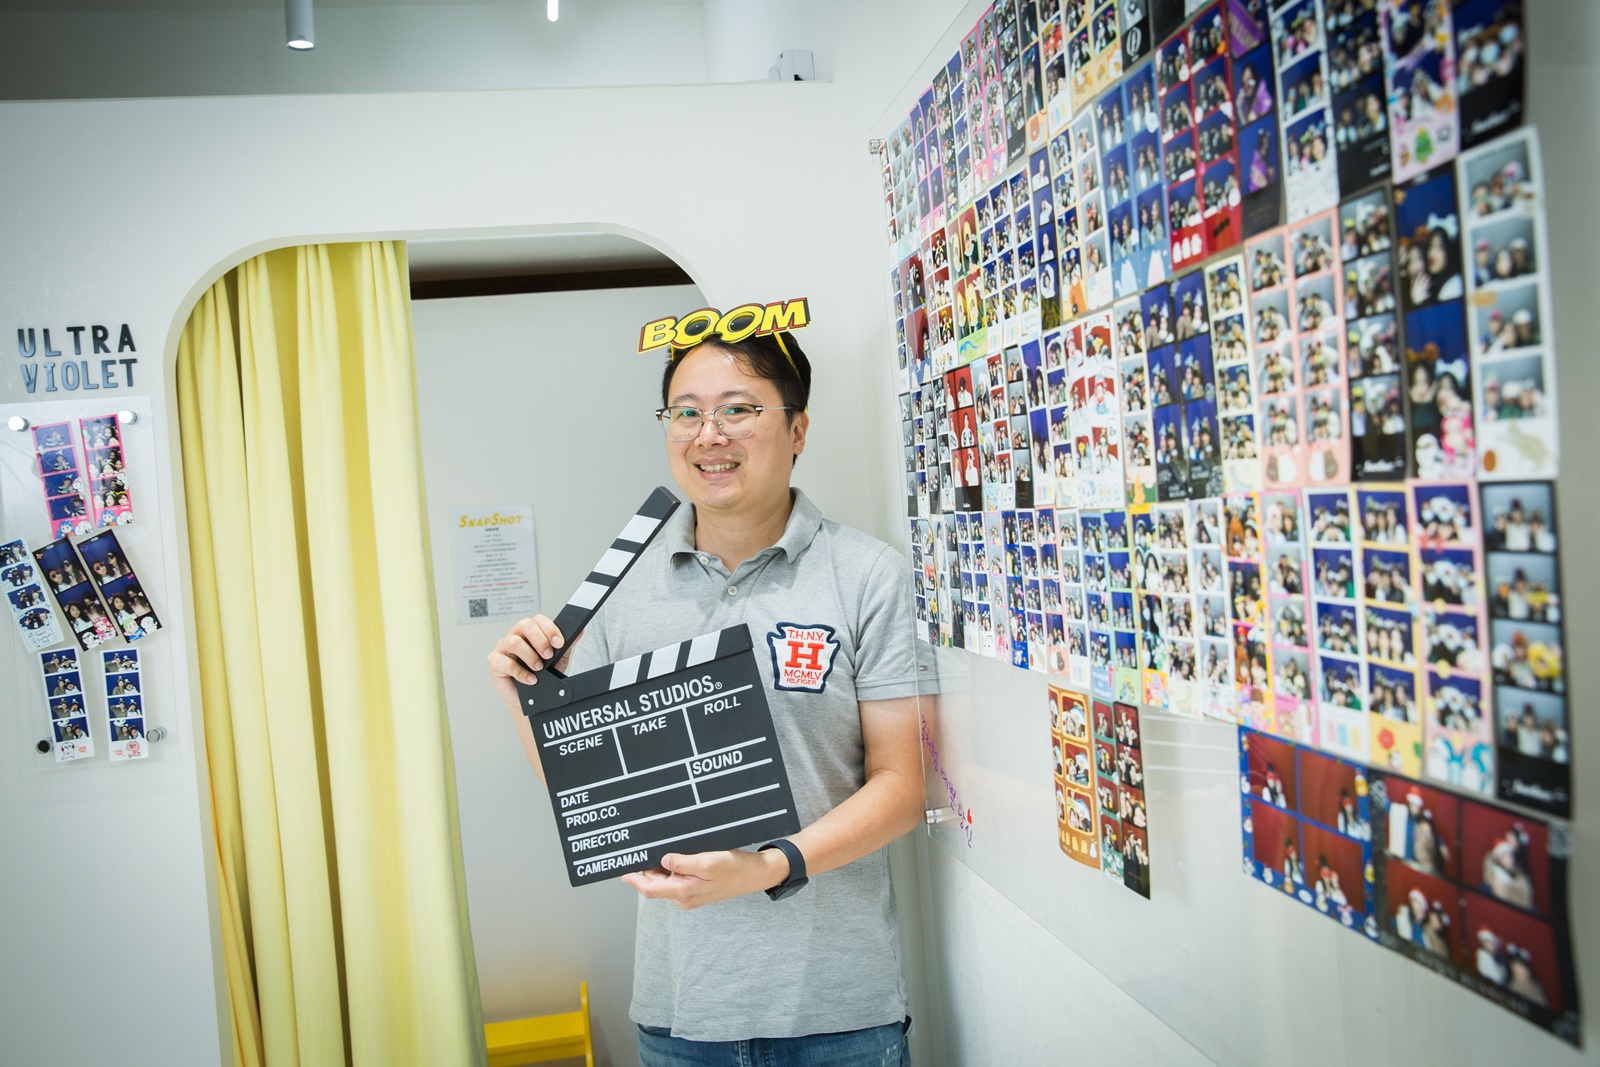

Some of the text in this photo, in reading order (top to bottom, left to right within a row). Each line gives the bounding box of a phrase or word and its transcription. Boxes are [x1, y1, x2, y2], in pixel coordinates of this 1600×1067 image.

[638, 297, 812, 354] BOOM
[17, 323, 137, 358] ULTRA
[20, 359, 138, 394] VIOLET
[785, 640, 824, 671] H
[783, 669, 823, 681] MCMLV
[786, 678, 817, 686] HILFIGER
[703, 696, 742, 716] ROLL
[543, 700, 636, 740] UNIVERSAL
[631, 715, 668, 737] TAKE
[558, 734, 604, 756] SCENE
[692, 750, 743, 775] SOUND
[560, 791, 590, 809] DATE
[565, 806, 620, 829] PROD.CO.
[957, 803, 973, 848] 당신
[571, 828, 630, 853] DIRECTOR
[576, 850, 649, 878] CAMERAMAN
